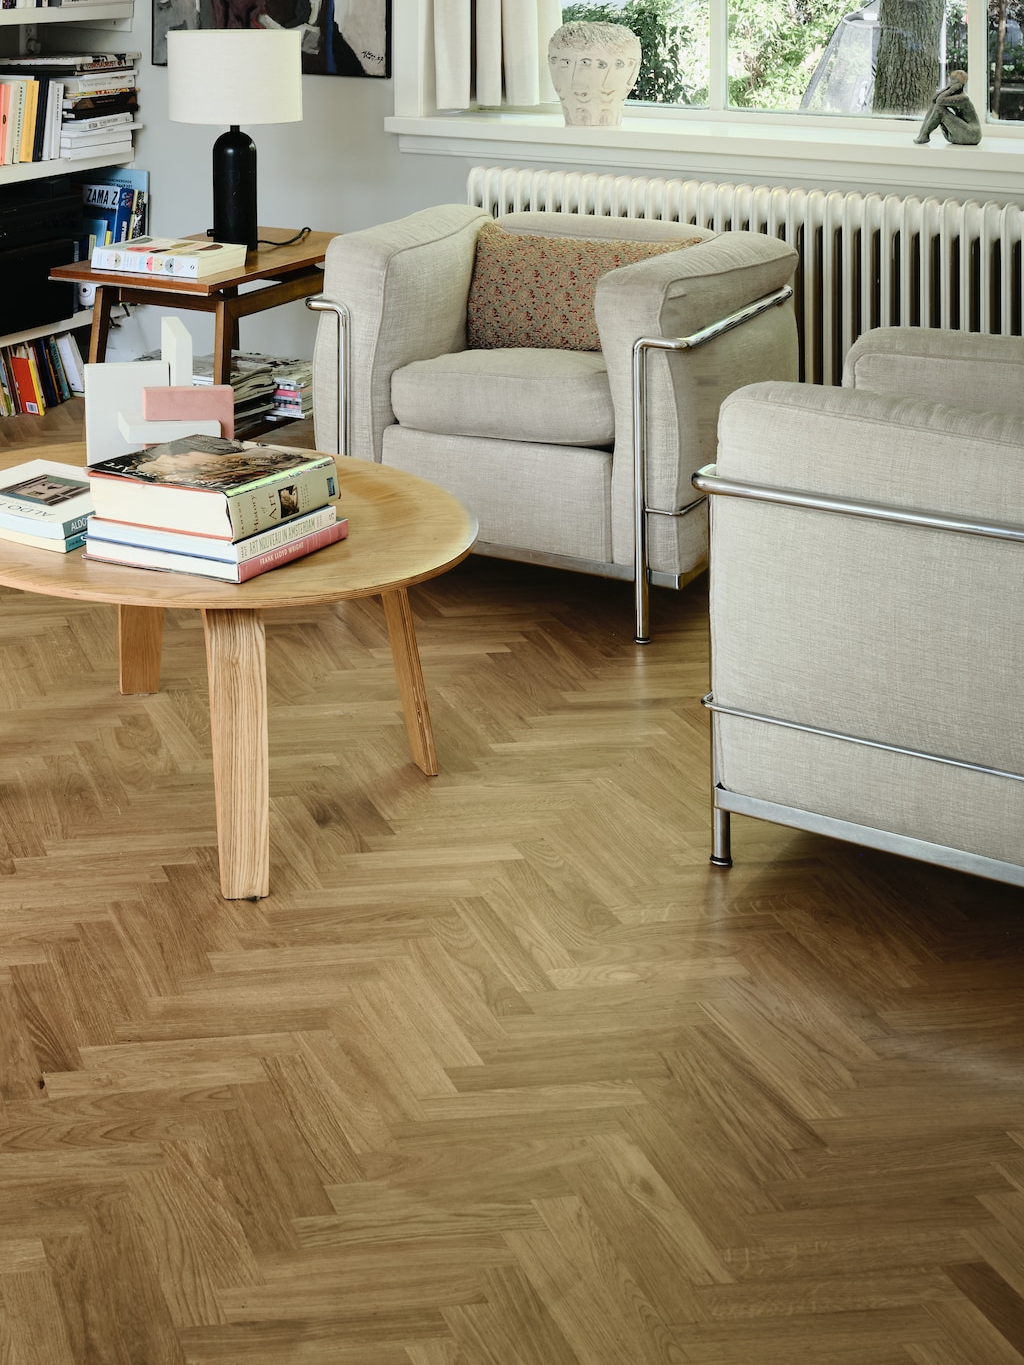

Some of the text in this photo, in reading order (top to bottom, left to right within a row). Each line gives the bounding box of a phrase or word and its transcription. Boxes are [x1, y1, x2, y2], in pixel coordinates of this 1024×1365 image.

[87, 189, 108, 204] ZAMA
[103, 463, 130, 473] Art
[8, 505, 56, 517] ALDO
[268, 493, 277, 520] Art
[71, 518, 87, 531] ALDO
[237, 501, 245, 534] JANSON
[249, 544, 258, 555] ART
[259, 534, 282, 553] NOUVEAU
[282, 532, 287, 542] IN
[288, 519, 315, 540] AMSTERDAM
[259, 541, 304, 566] FRANK LLOYD WRIGHT
